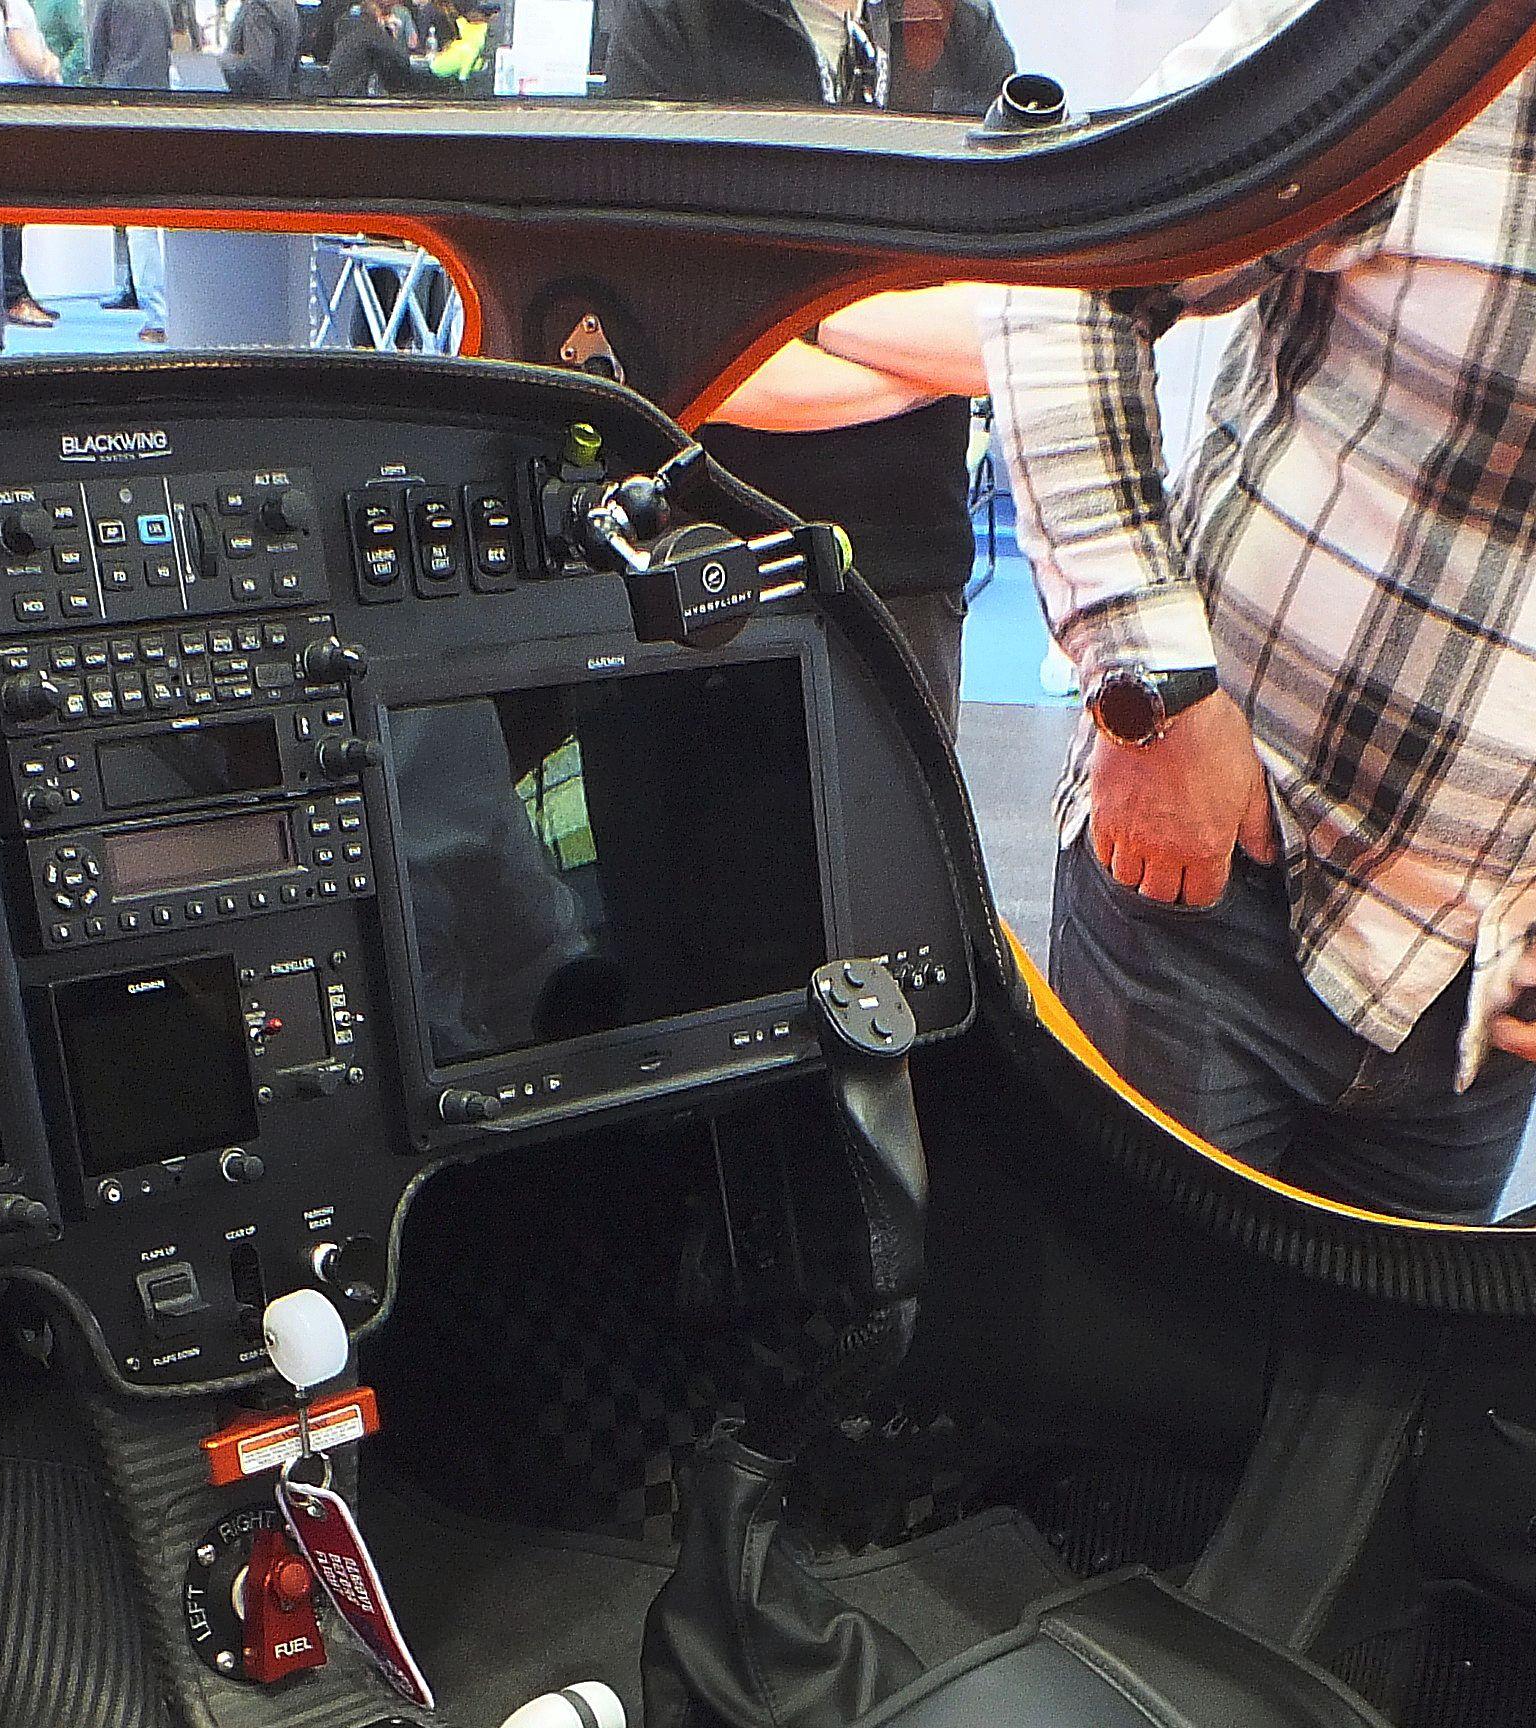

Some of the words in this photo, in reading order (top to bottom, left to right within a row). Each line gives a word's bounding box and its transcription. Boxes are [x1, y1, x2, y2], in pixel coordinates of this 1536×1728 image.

[61, 431, 167, 455] BLACKWING
[219, 1510, 277, 1543] RIGHT
[187, 1584, 212, 1643] LEFT
[274, 1636, 314, 1660] FUEL
